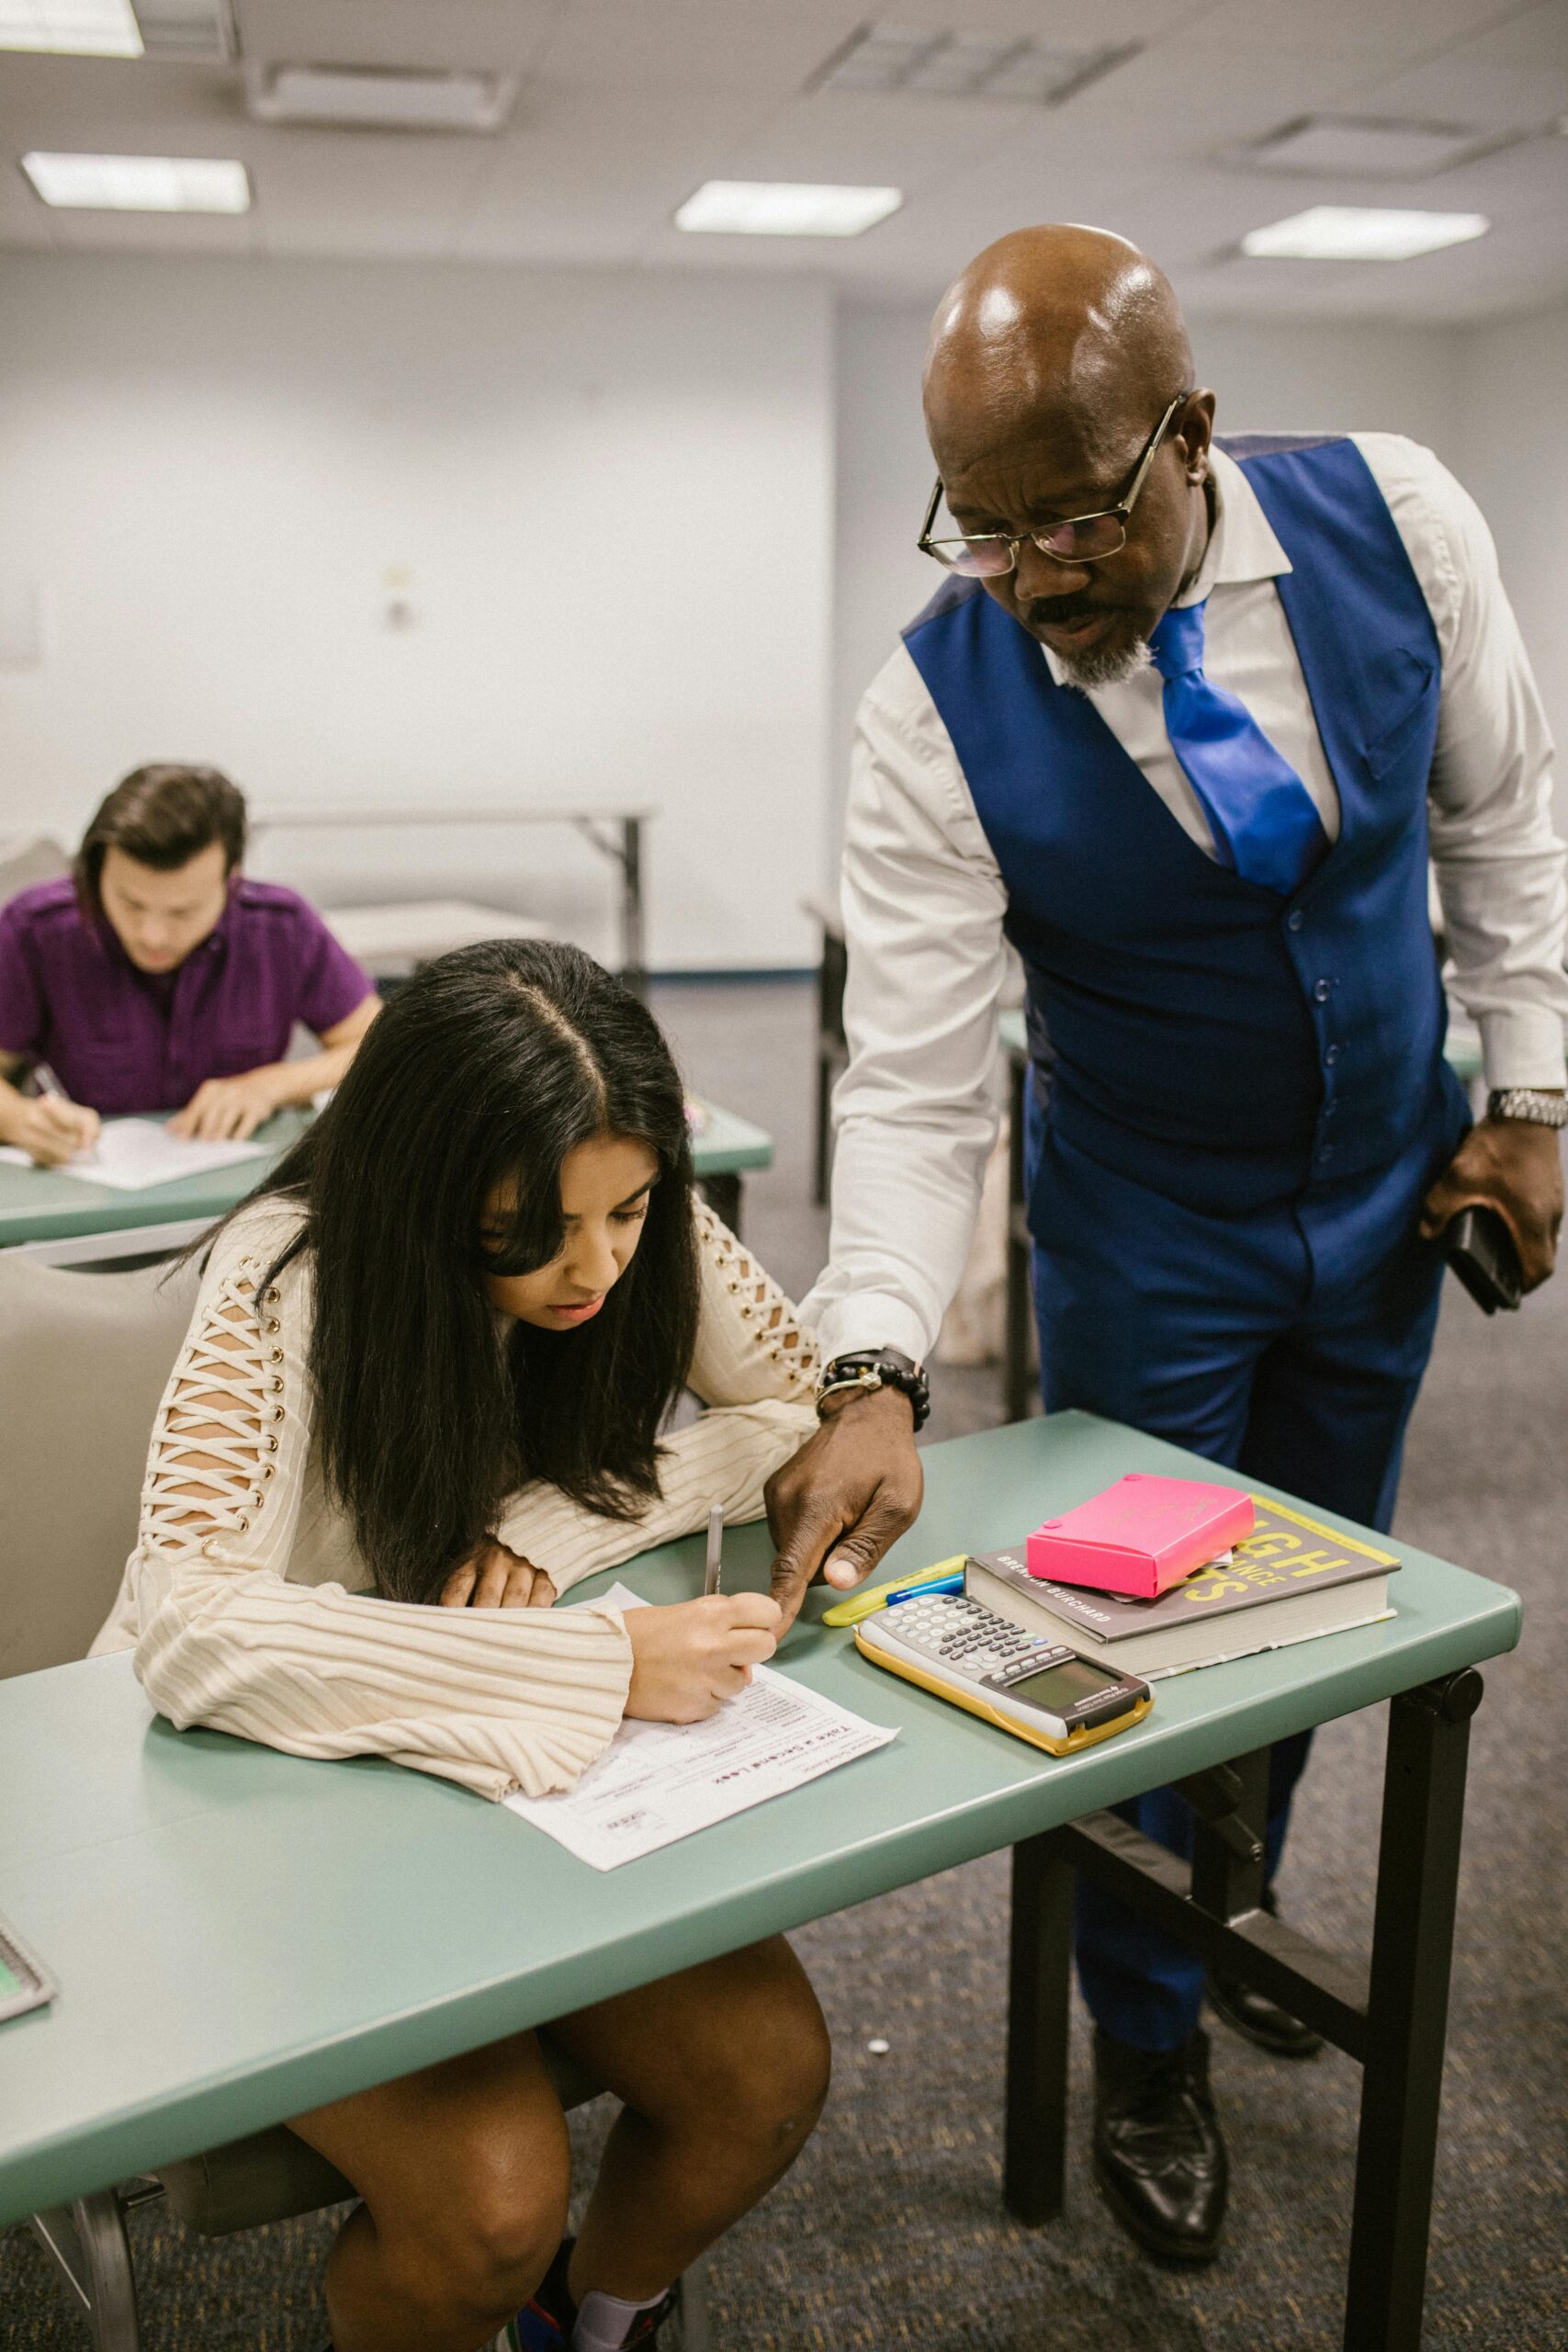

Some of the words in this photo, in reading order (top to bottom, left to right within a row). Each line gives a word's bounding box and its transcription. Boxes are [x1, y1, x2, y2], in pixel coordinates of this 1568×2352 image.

[1236, 1520, 1352, 1578] GH
[1228, 1558, 1287, 1587] ANCE
[1046, 1587, 1111, 1623] BURCHARD
[817, 1724, 852, 1741] Take
[751, 1745, 805, 1770] Second
[711, 1767, 750, 1784] Look
